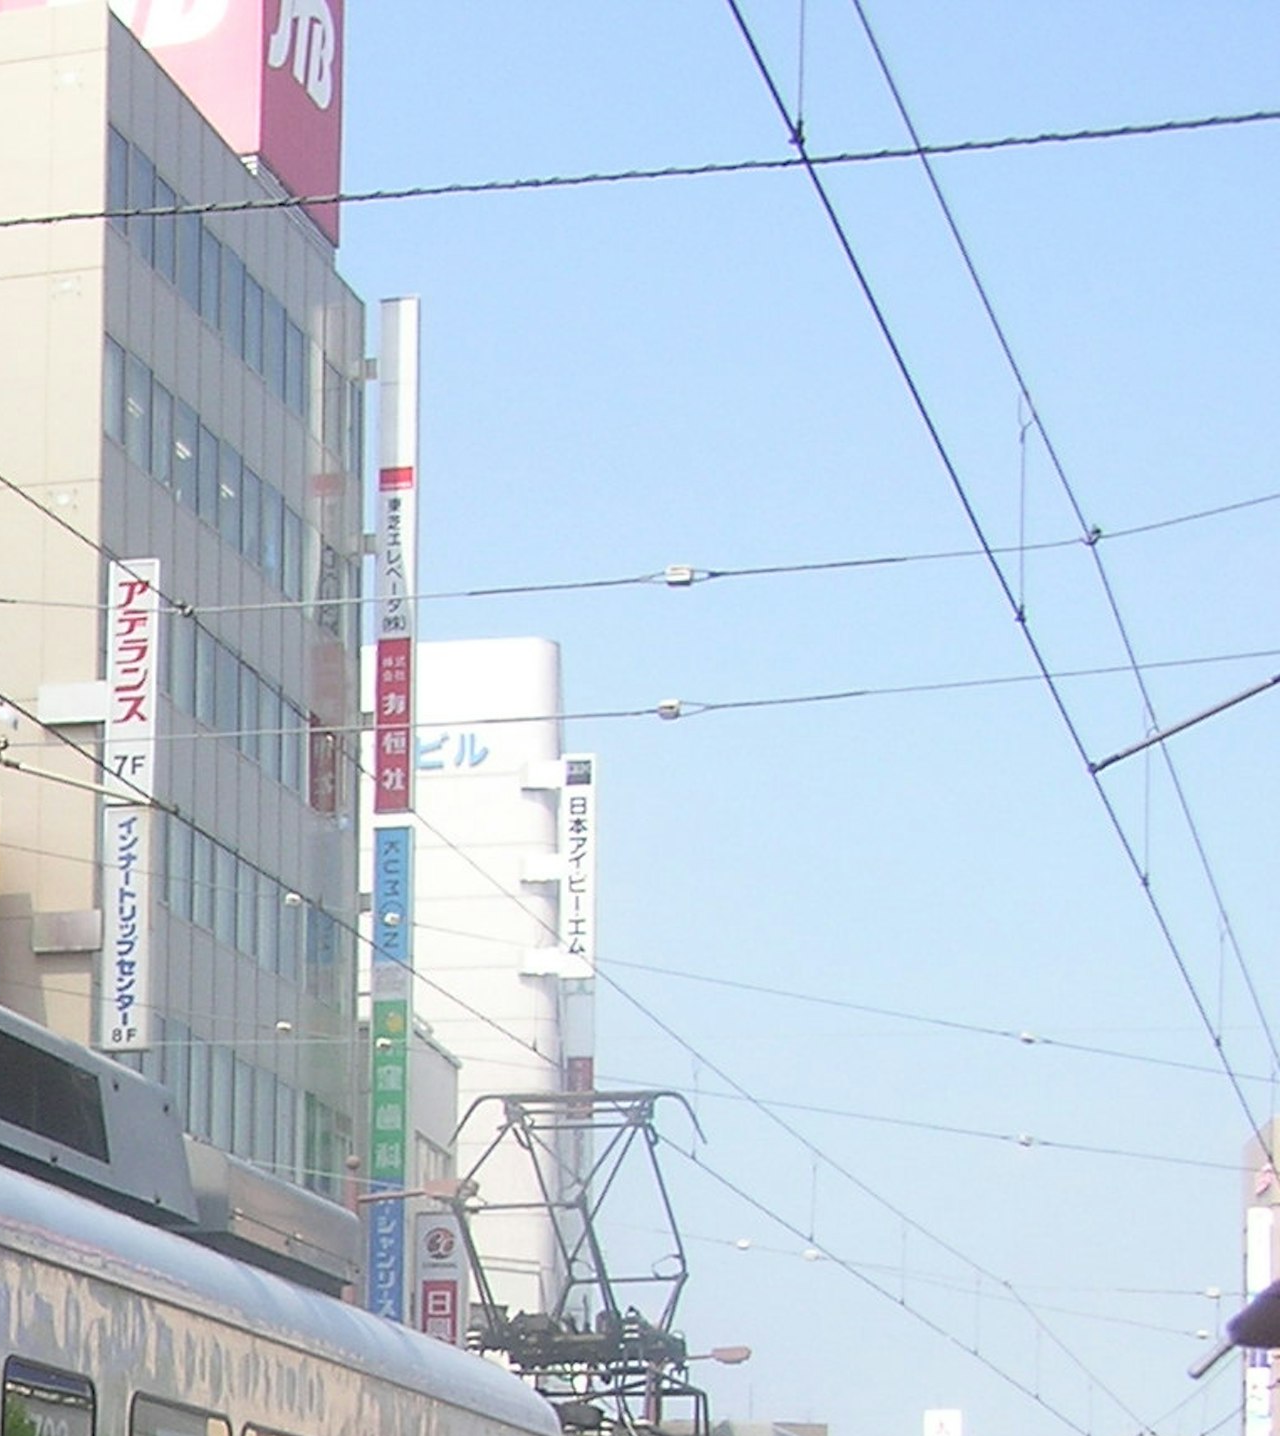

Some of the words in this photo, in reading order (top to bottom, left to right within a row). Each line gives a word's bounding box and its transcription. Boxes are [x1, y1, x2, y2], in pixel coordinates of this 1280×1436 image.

[267, 0, 336, 110] JTB
[113, 580, 149, 724] アデランス
[113, 755, 145, 777] 7F
[116, 816, 138, 1026] インナートリップセンター
[111, 1028, 138, 1042] 8F
